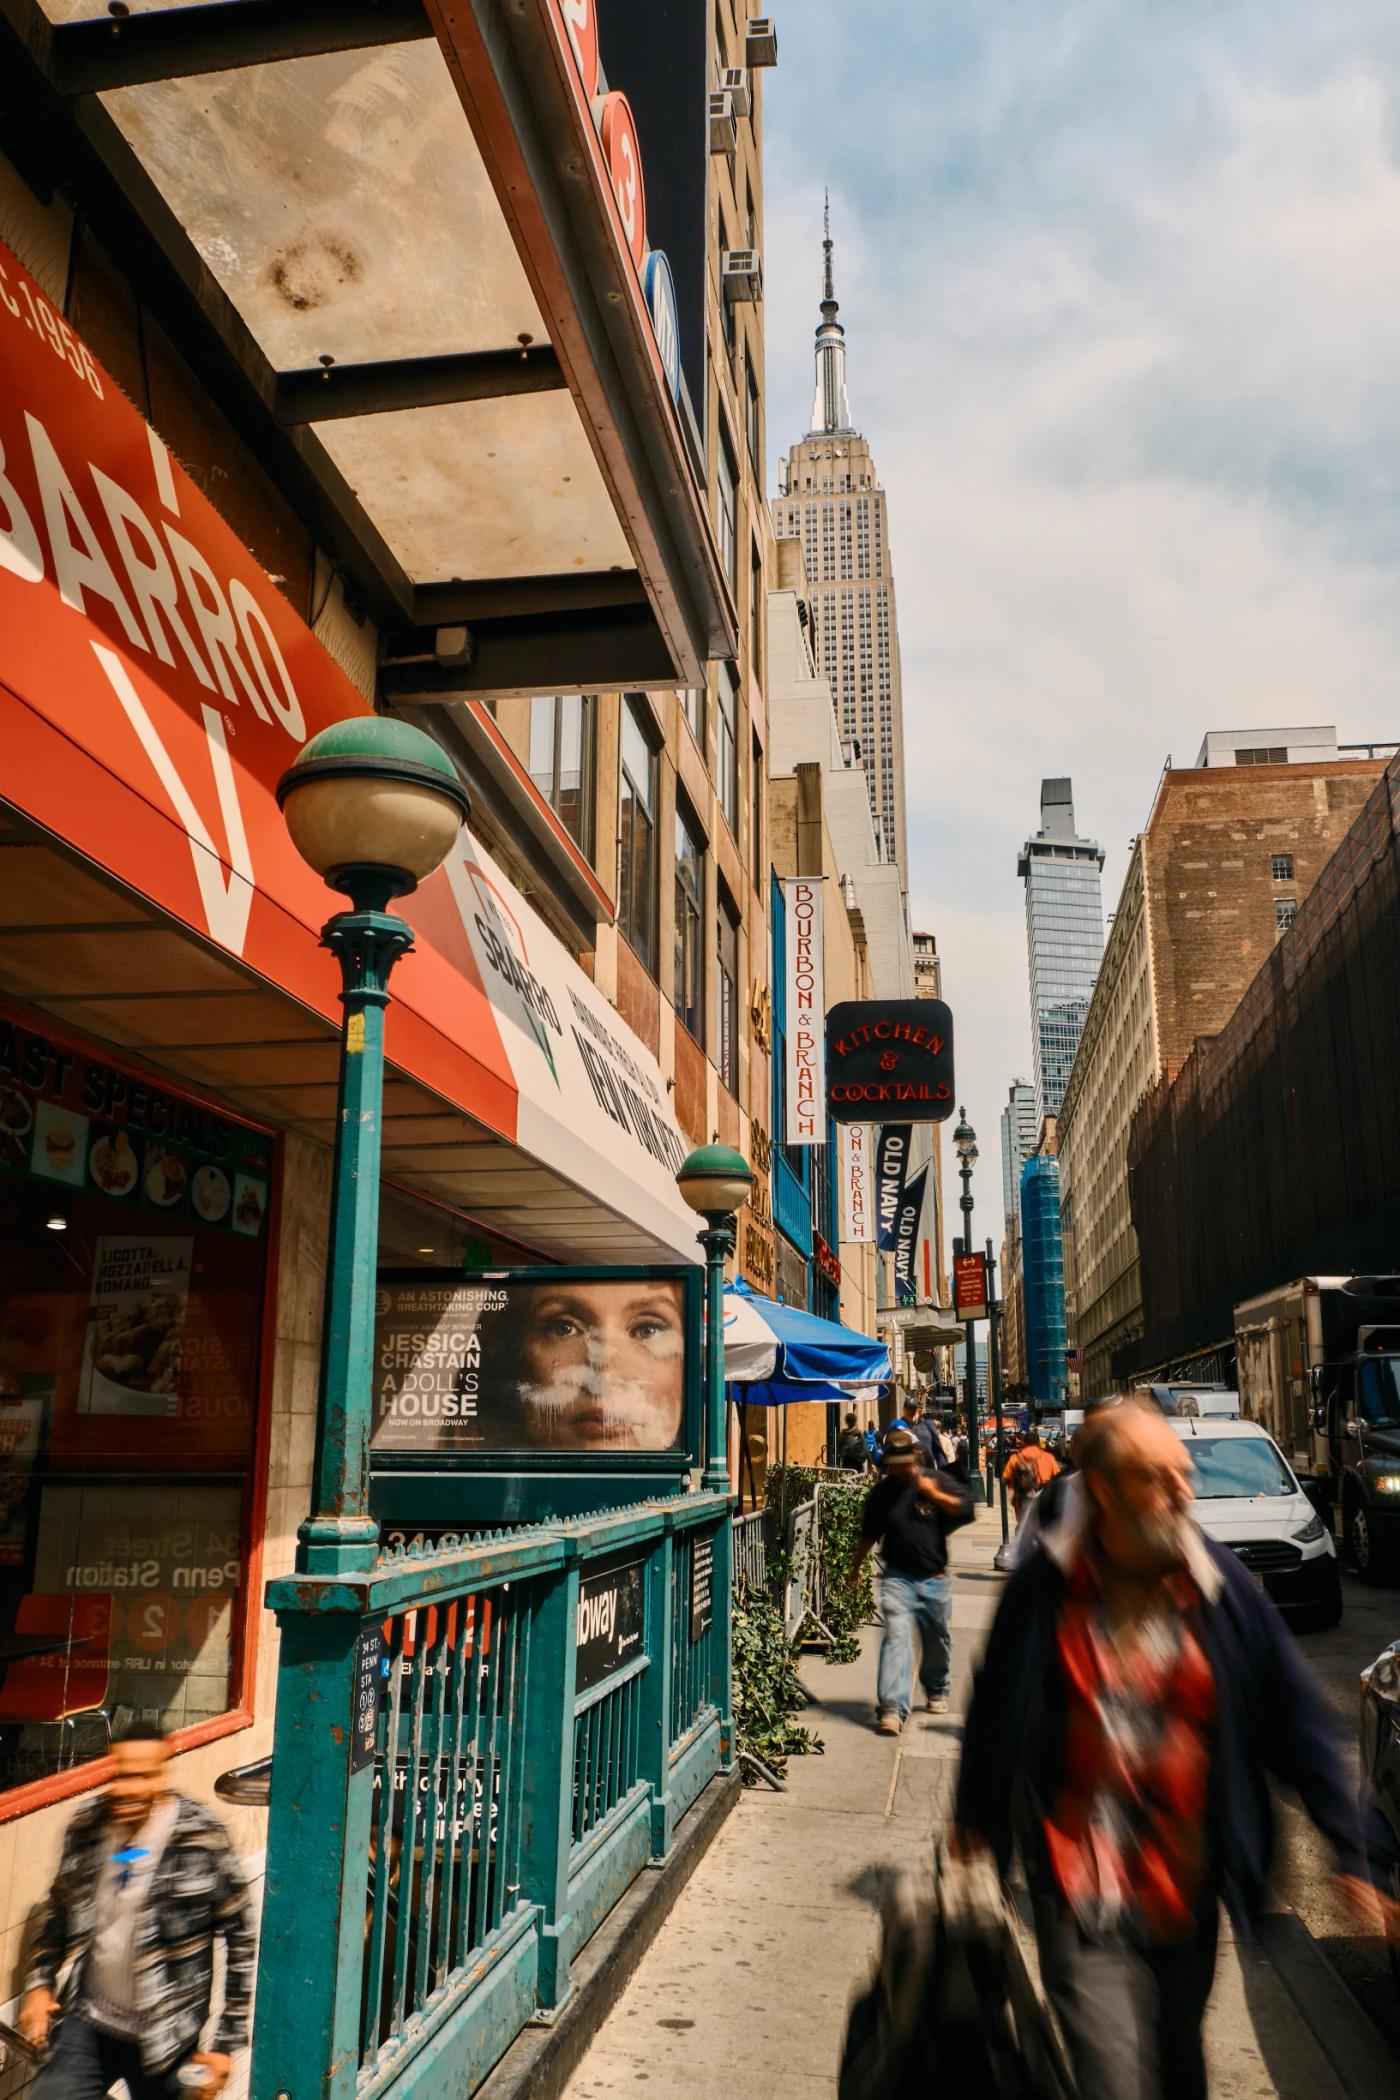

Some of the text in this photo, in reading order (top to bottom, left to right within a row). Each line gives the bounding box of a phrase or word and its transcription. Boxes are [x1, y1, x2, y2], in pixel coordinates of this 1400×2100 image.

[616, 131, 637, 245] 3
[473, 912, 563, 1037] SBARRO
[795, 884, 816, 1136] BOURBON & BRANCH
[833, 1019, 945, 1058] KITCHEN
[880, 1049, 898, 1072] &
[568, 1023, 632, 1136] NEW
[831, 1081, 951, 1103] COCKTAILS
[880, 1136, 904, 1233] OLD NAVY
[850, 1166, 864, 1237] BRANCH
[895, 1206, 916, 1281] OLD NAVY
[397, 1302, 473, 1312] BREATHTAKING
[398, 1290, 509, 1302] AN ASTONISHING,
[452, 1323, 482, 1331] WINNER
[382, 1333, 482, 1352] JESSICA
[381, 1352, 480, 1369] CHASTAIN
[382, 1372, 479, 1392] A DOLL'S
[379, 1394, 478, 1417] HOUSE
[423, 1419, 469, 1427] BROADWAY
[576, 1586, 618, 1647] bway
[361, 1655, 378, 1672] PENN
[361, 1673, 372, 1689] STA
